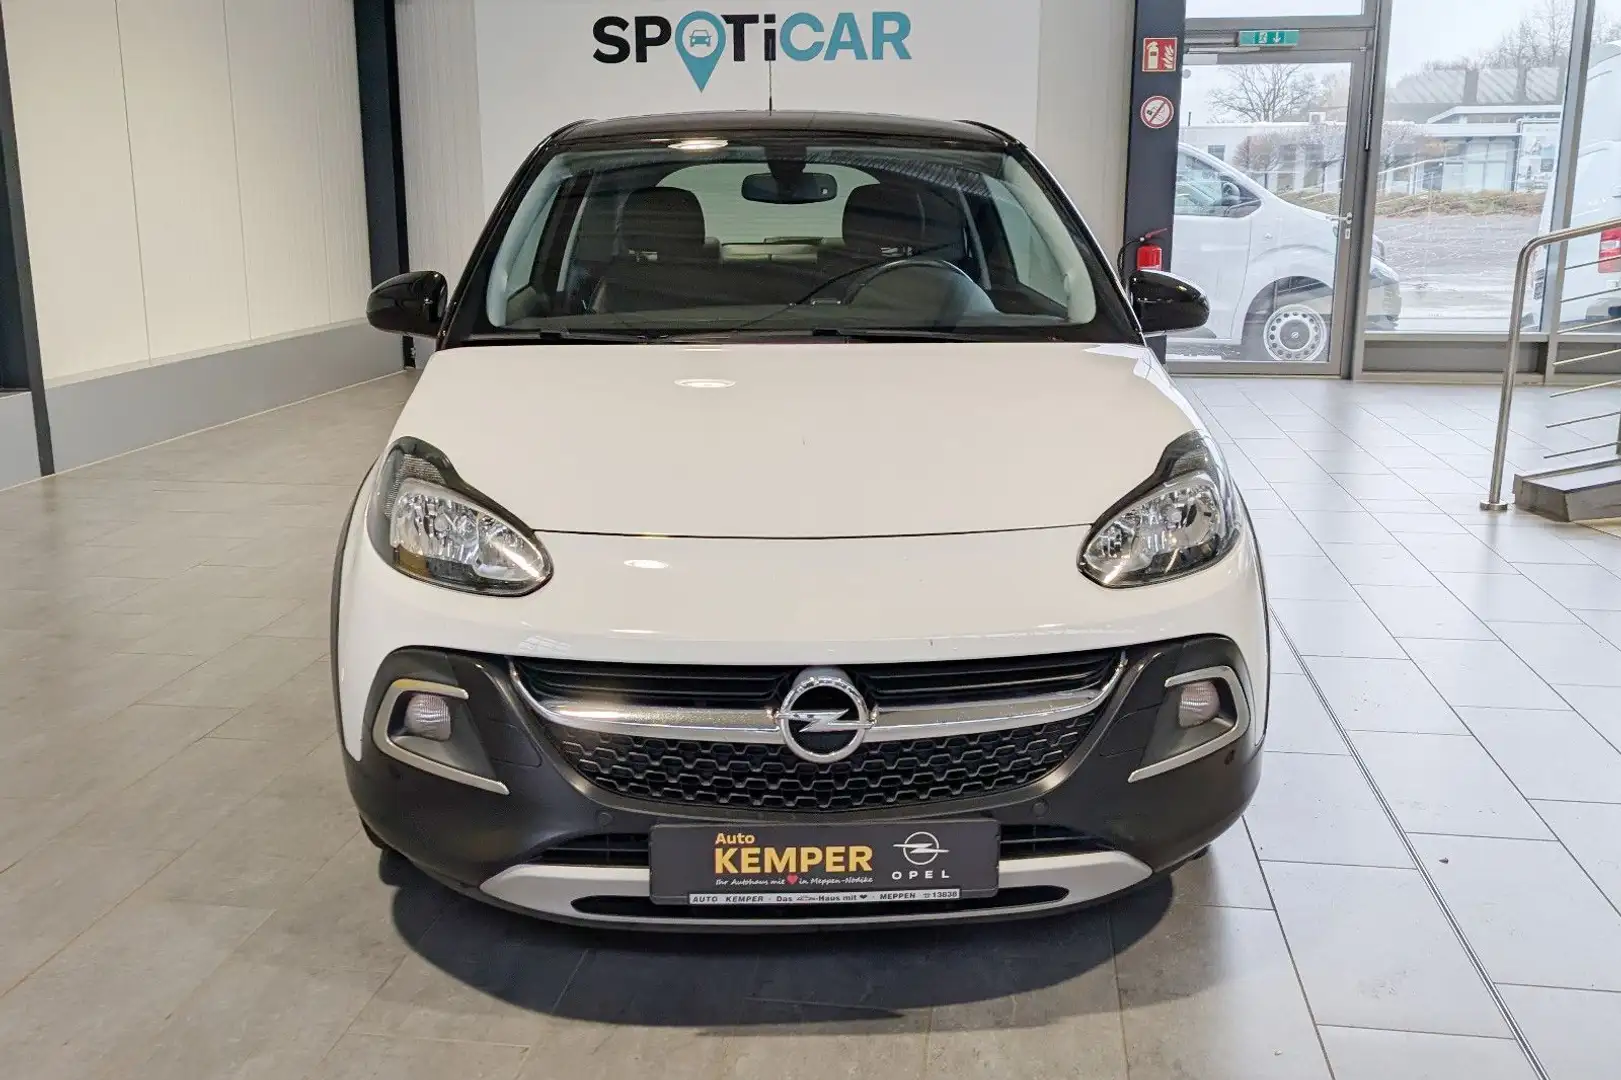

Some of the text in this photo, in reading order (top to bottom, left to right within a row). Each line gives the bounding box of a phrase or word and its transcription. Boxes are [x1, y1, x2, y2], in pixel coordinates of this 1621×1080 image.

[715, 832, 755, 845] Auto
[715, 846, 873, 874] KEMPER
[892, 870, 949, 880] OPEL
[730, 878, 768, 886] Autohaus
[725, 895, 764, 903] KEMPER
[879, 892, 916, 900] MEPPEN
